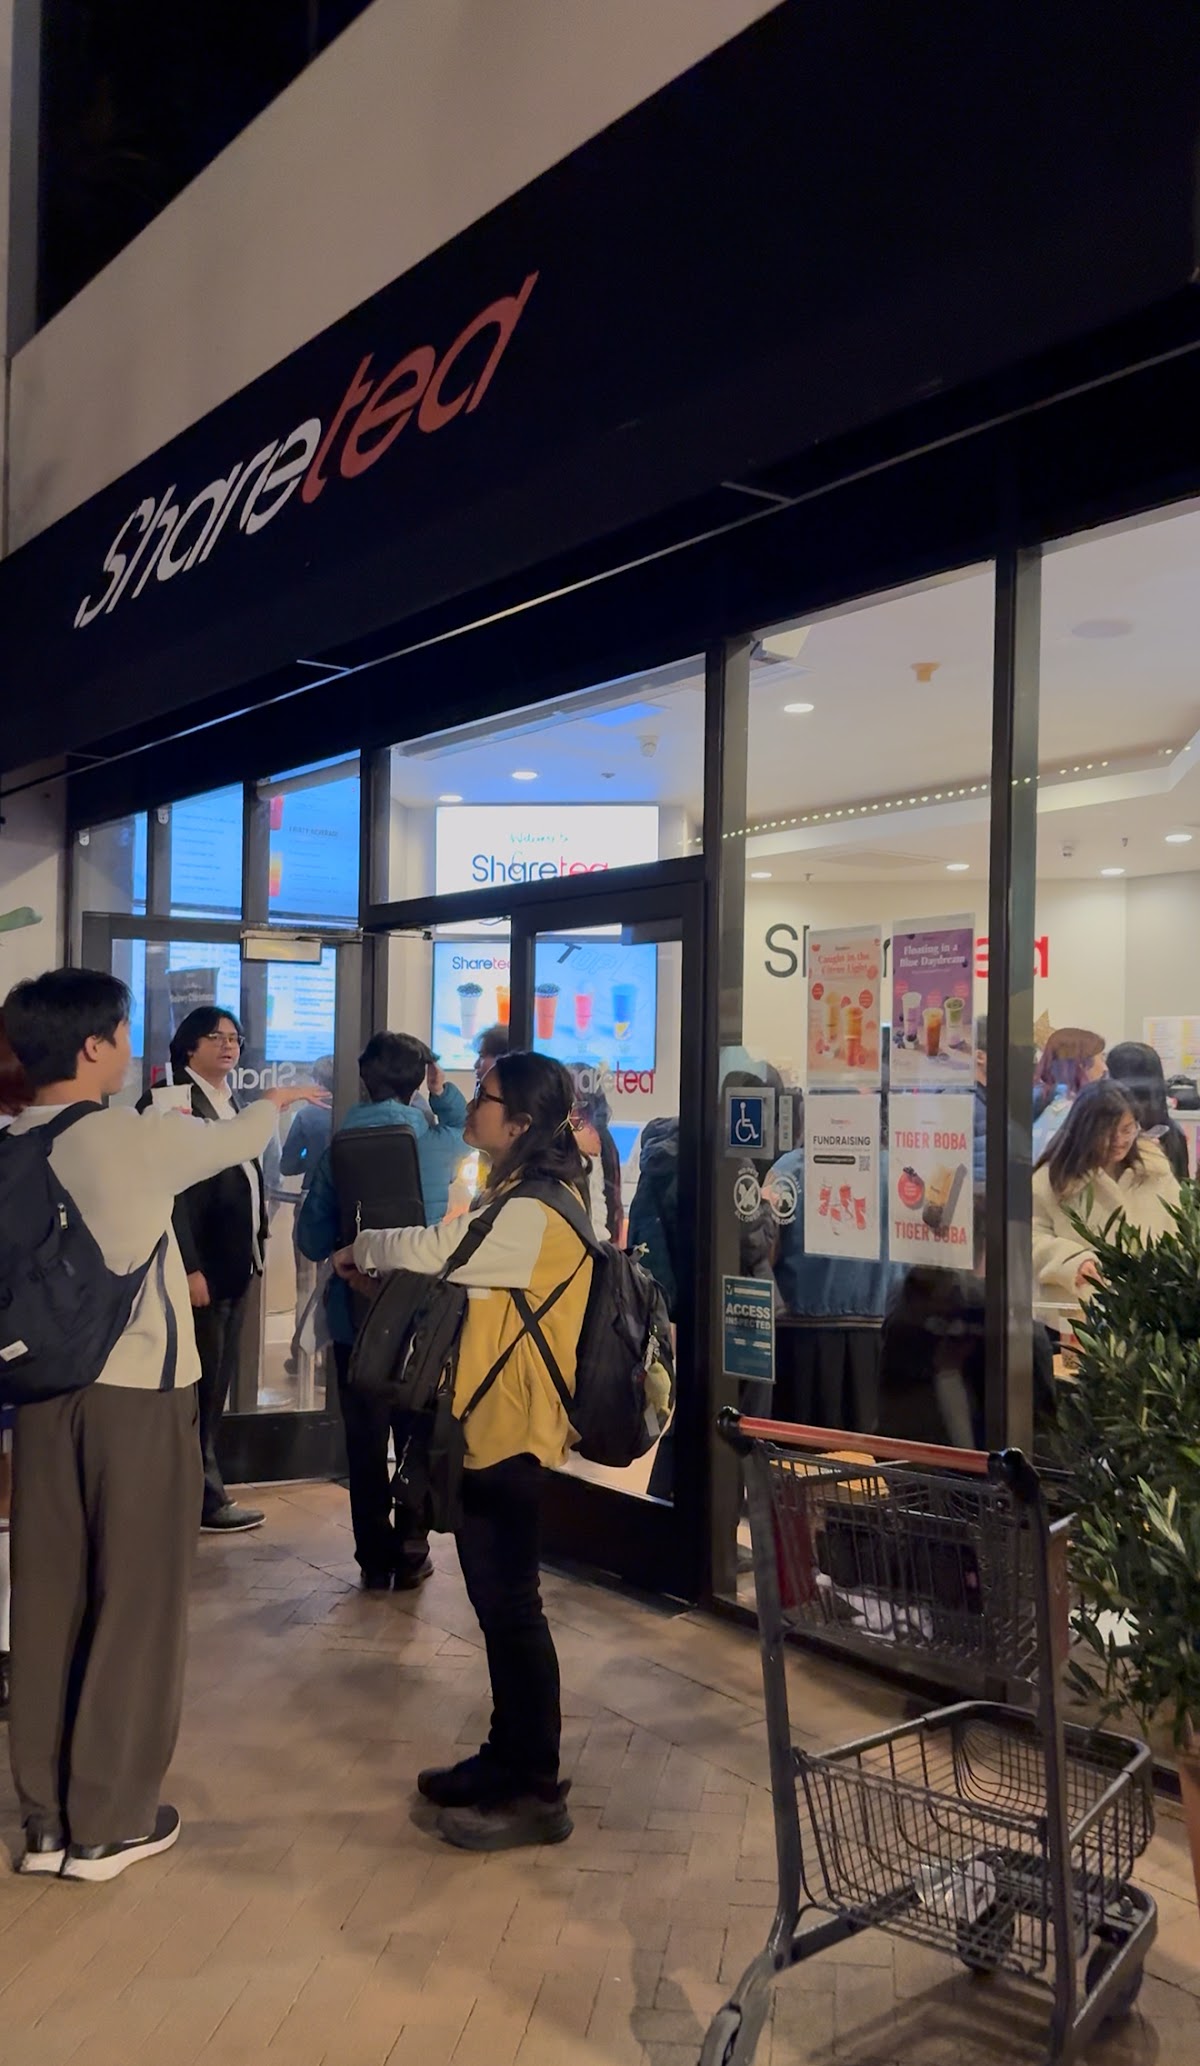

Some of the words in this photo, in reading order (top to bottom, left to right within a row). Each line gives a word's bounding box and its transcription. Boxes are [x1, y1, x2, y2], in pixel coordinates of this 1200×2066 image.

[73, 270, 539, 630] Sharetea
[903, 944, 939, 956] Floating
[941, 943, 950, 951] in
[452, 956, 511, 970] Sharete
[900, 957, 919, 968] Blue
[921, 955, 966, 968] Daydream
[813, 1135, 871, 1147] FUNDRAISING
[895, 1131, 930, 1149] TIGER
[934, 1132, 967, 1150] BOBA
[895, 1221, 930, 1240] TIGER
[934, 1226, 967, 1245] BOBA
[726, 1302, 771, 1320] ACCESS
[725, 1316, 771, 1330] INSPECTED
